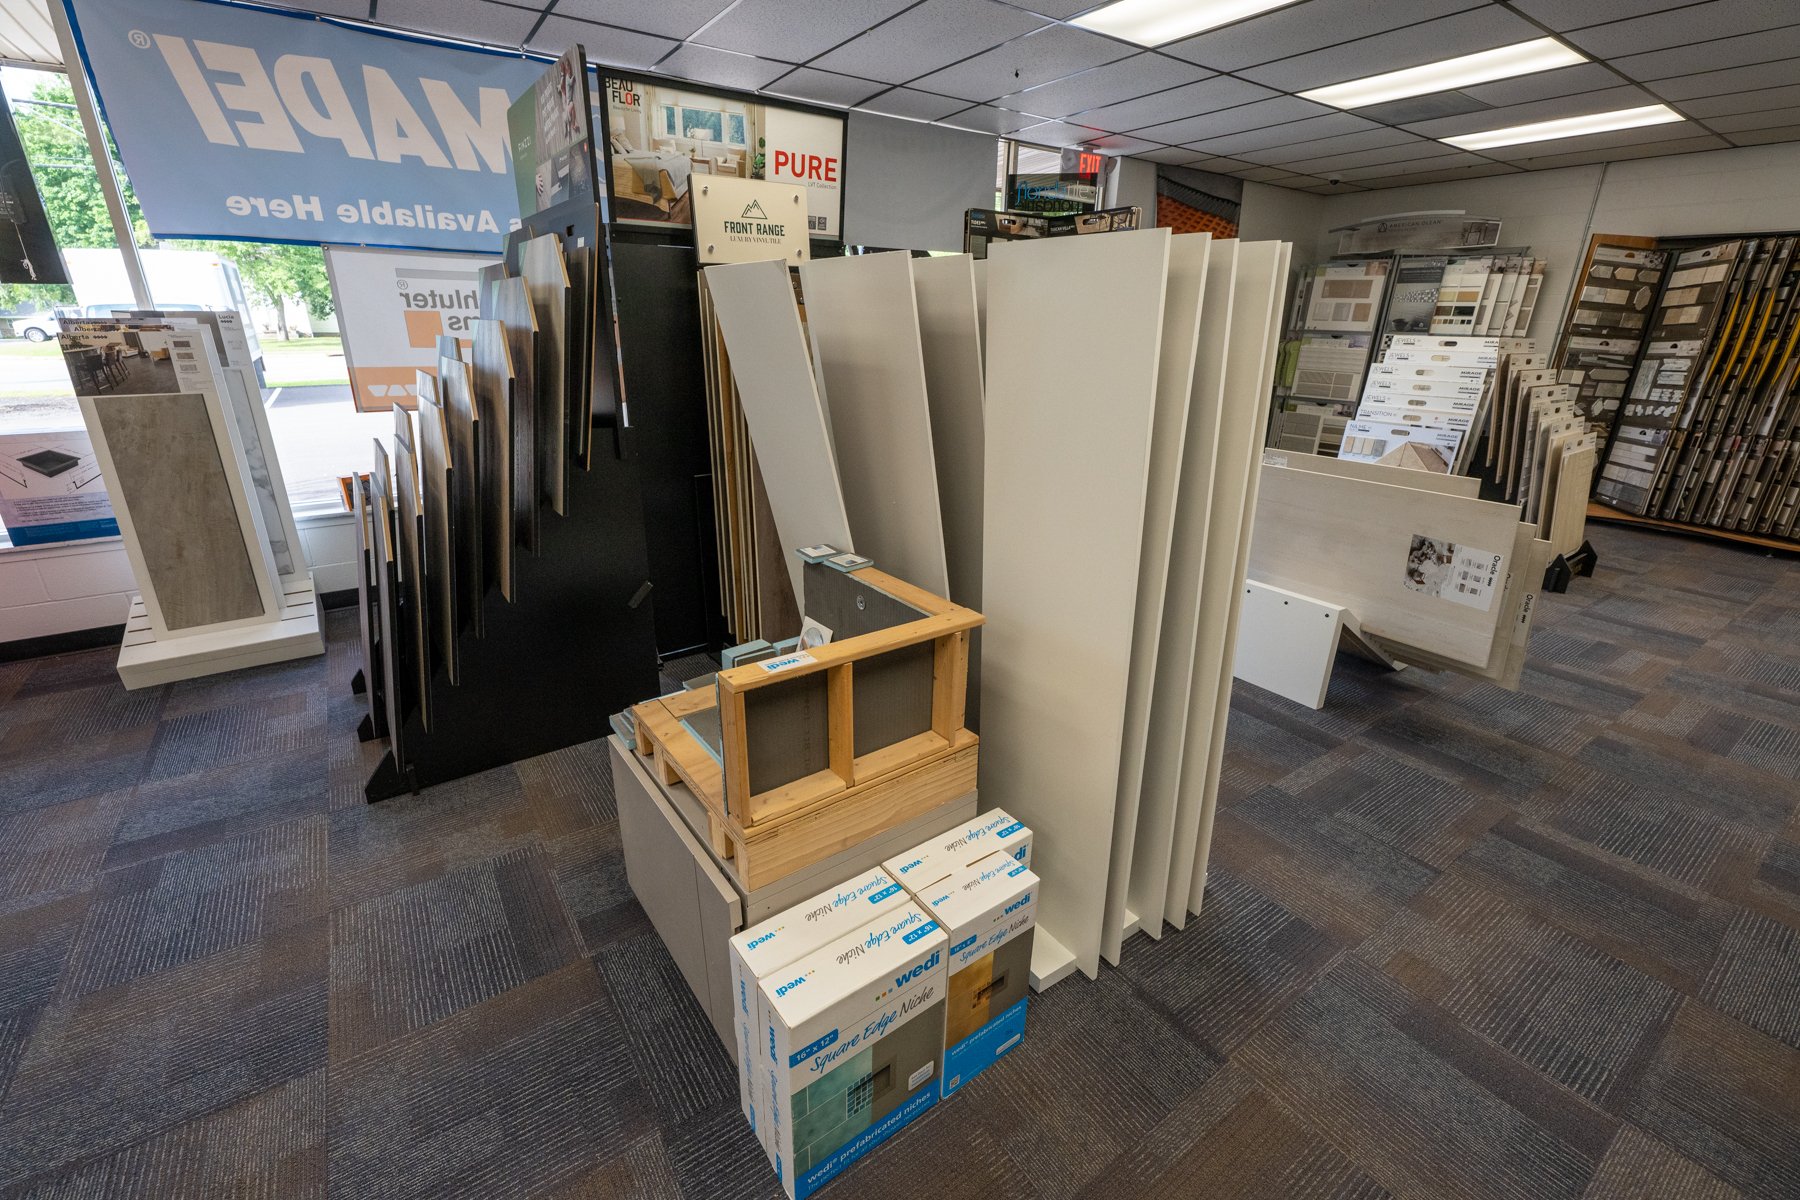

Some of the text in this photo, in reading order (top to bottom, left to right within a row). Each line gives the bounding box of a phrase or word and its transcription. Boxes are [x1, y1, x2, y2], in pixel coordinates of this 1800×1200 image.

[604, 76, 633, 92] BEAU
[612, 90, 640, 106] FLOR
[774, 150, 838, 182] PURE
[1079, 153, 1102, 178] EXIT
[724, 221, 786, 236] FRONT RANGE
[1490, 555, 1501, 576] Oracle
[1524, 594, 1534, 614] Oracle
[767, 658, 799, 670] wedi
[944, 816, 1011, 852] Square Edge Niche
[900, 860, 922, 874] wedi
[962, 880, 980, 890] Niche
[804, 875, 888, 922] Square Edge Niche
[932, 894, 950, 906] wedi
[1004, 893, 1030, 914] wedi
[747, 932, 776, 950] wedi
[836, 912, 922, 964] Square Edge Niche
[960, 915, 1029, 963] Square Edge Niche
[896, 950, 940, 988] wedi
[776, 976, 806, 998] wedi
[810, 986, 934, 1074] Square Edge Niche
[769, 1025, 778, 1066] wedi
[796, 1049, 810, 1061] 16"
[821, 1034, 834, 1046] 12"
[840, 1112, 902, 1162] prefabricated
[904, 1092, 930, 1114] niches
